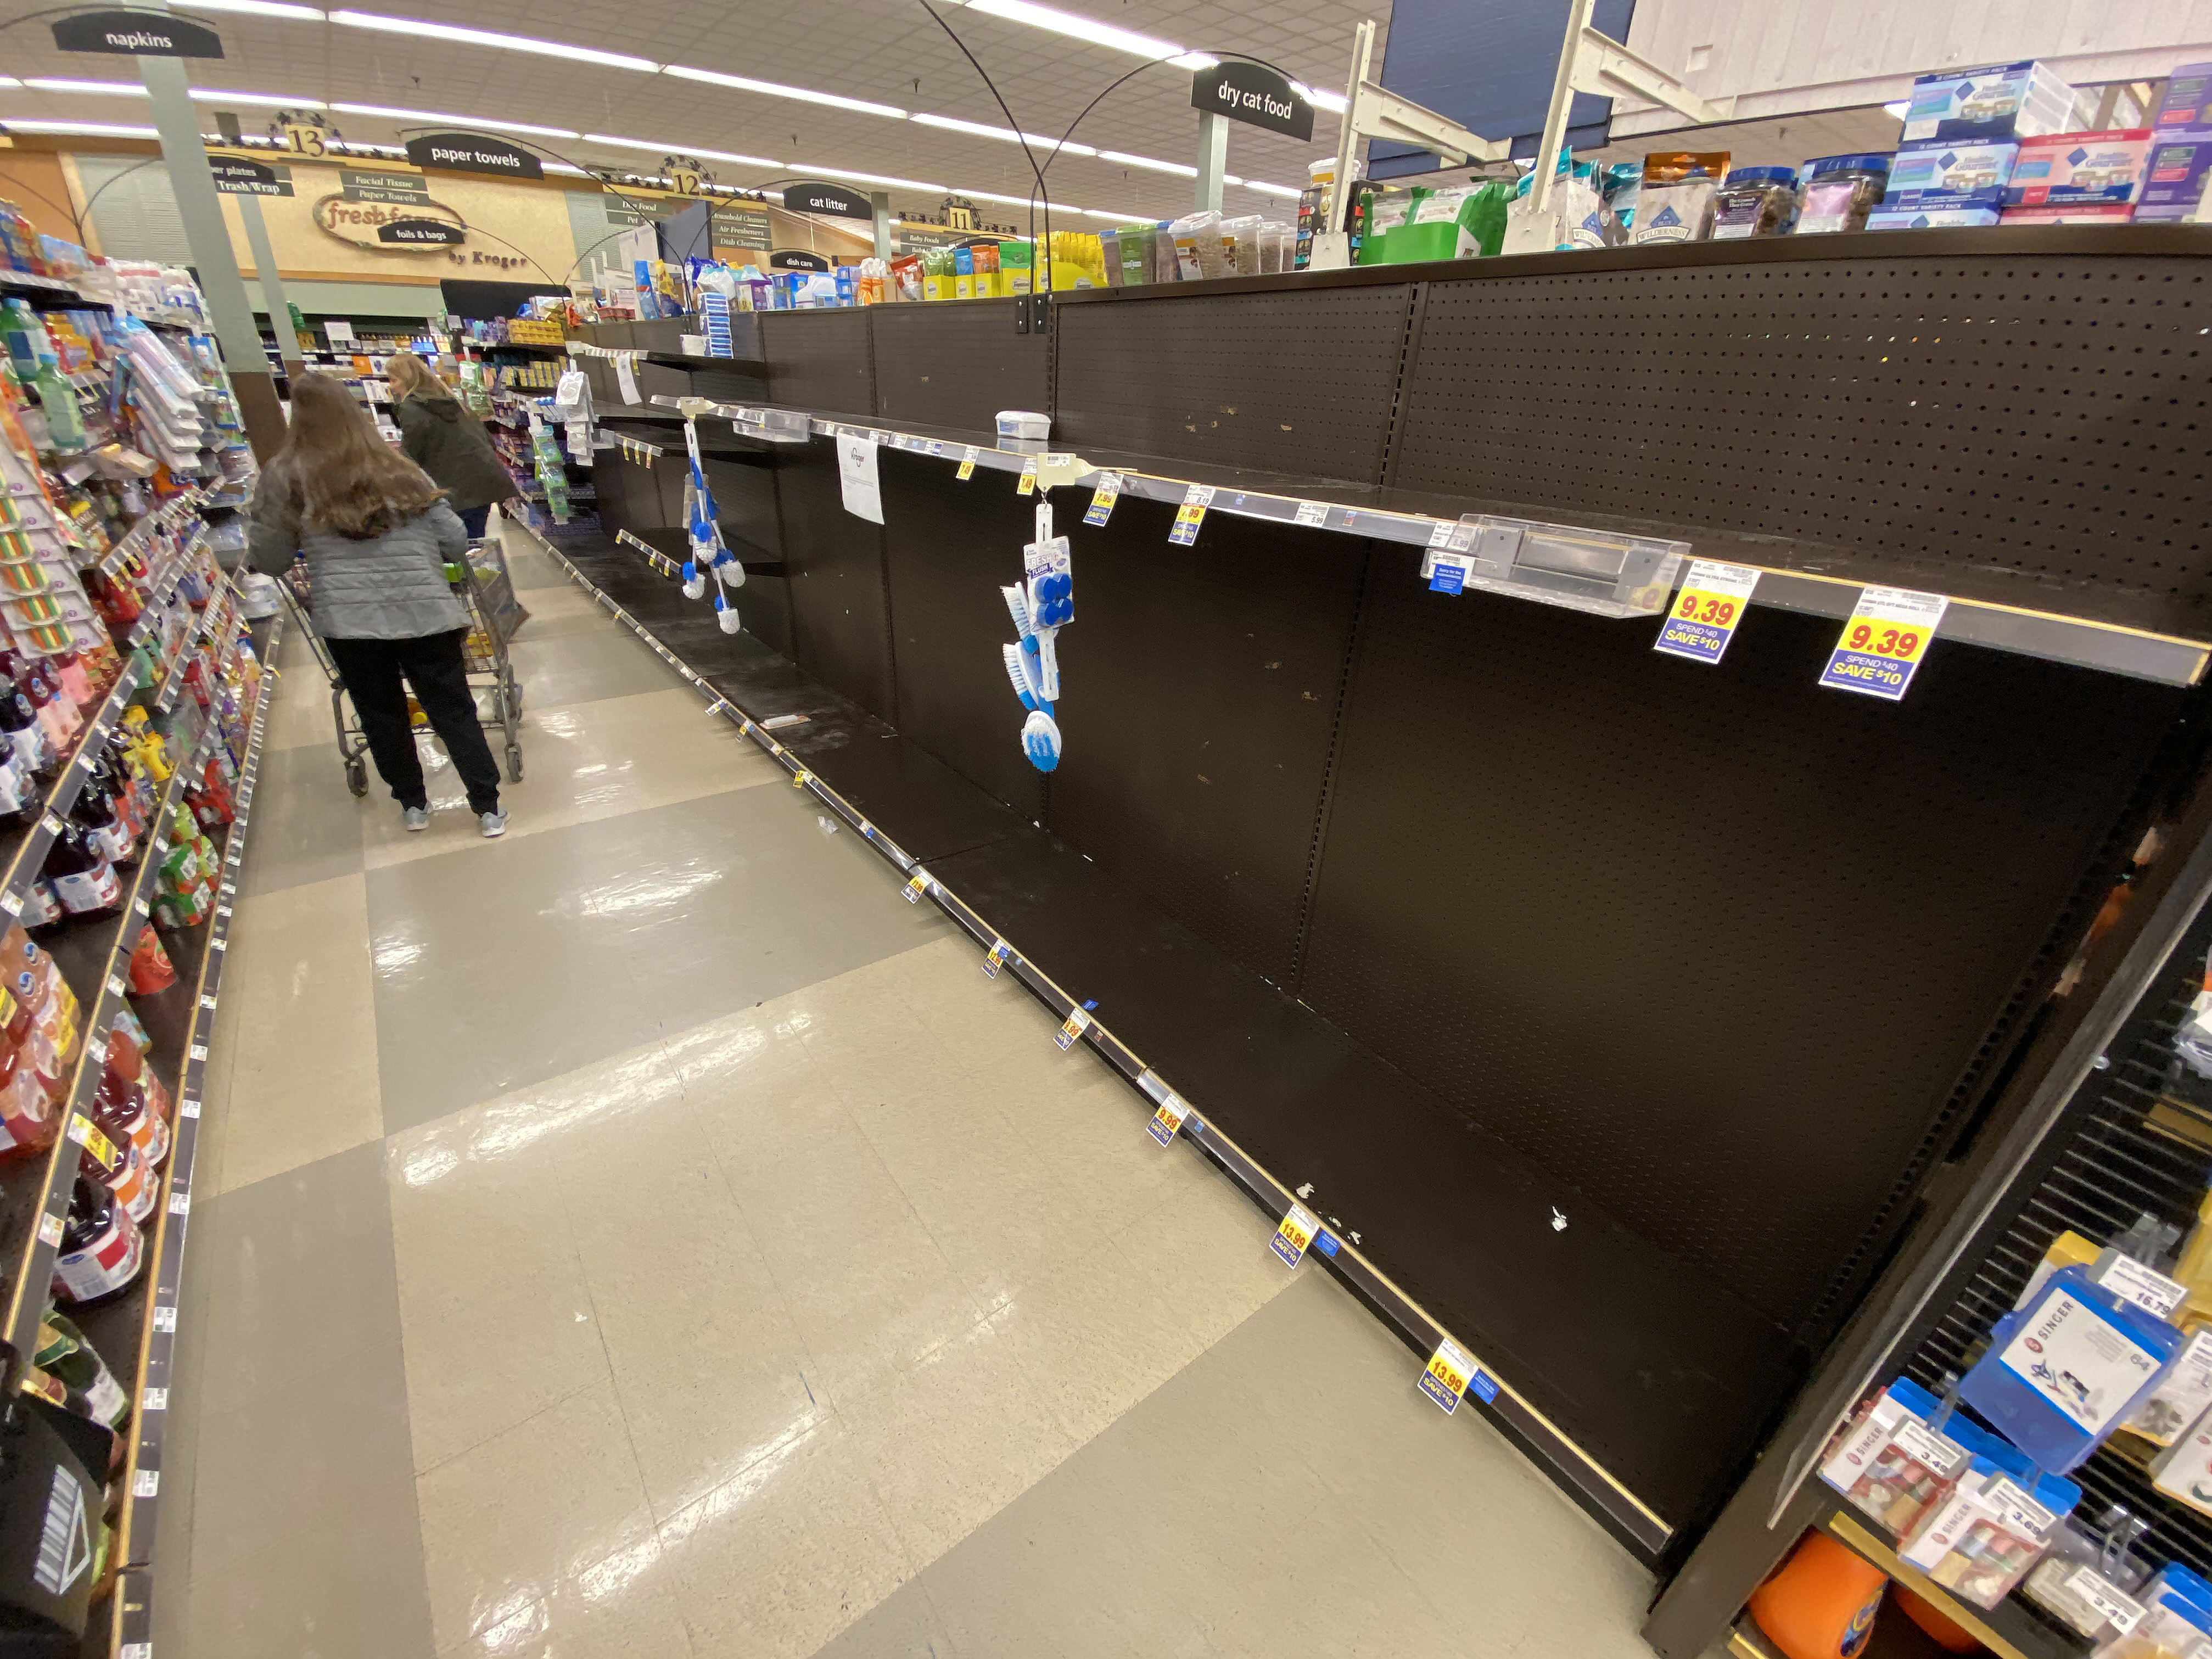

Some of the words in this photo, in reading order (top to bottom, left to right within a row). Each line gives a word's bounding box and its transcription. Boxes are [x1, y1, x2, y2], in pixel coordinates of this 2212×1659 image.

[105, 31, 172, 49] napkins
[1218, 80, 1240, 108] dry
[1242, 92, 1262, 110] cat
[1264, 93, 1292, 120] food
[289, 130, 325, 157] 13
[431, 148, 472, 163] paper
[474, 150, 520, 167] towels
[226, 166, 257, 176] plates
[356, 176, 384, 186] Facial
[385, 177, 413, 188] Tissue
[673, 173, 699, 195] 12
[359, 189, 385, 200] Paper
[387, 192, 417, 203] Towels
[810, 198, 824, 208] cat
[825, 197, 848, 211] litter
[639, 202, 657, 212] Food
[627, 215, 638, 224] Pet
[743, 216, 768, 224] Cleaners
[951, 211, 968, 231] 11
[396, 229, 415, 239] foils
[417, 230, 424, 239] &
[425, 230, 447, 241] bags
[719, 225, 730, 233] Air
[730, 226, 765, 237] Fresheners
[910, 234, 923, 244] Baby
[924, 236, 939, 244] Foods
[720, 238, 736, 246] Dish
[736, 239, 765, 250] Cleaning
[449, 250, 466, 265] by
[473, 251, 527, 269] Kroger
[786, 258, 800, 266] dish
[1026, 553, 1052, 569] FRESH
[1032, 563, 1048, 576] FLUSH
[1679, 595, 1734, 625] 9.39
[1676, 623, 1705, 635] SPEND
[1705, 629, 1718, 638] $40
[1665, 629, 1701, 646] SAVE
[1700, 636, 1721, 651] $10
[1849, 625, 1918, 658] 9.39
[1845, 654, 1881, 668] SPEND
[1882, 660, 1899, 671] $40
[1832, 662, 1877, 680] SAVE
[1876, 670, 1903, 685] $10
[1158, 1109, 1178, 1130] 9.99
[1282, 1223, 1306, 1249] 13.99
[1274, 1238, 1289, 1255] SAVE
[2136, 1292, 2171, 1315] 16.79
[2037, 1301, 2074, 1341] SINGER
[1433, 1361, 1462, 1392] 13.99
[1423, 1377, 1443, 1397] SAVE
[1856, 1427, 1884, 1455] SINGER
[1942, 1503, 1972, 1534] SINGER
